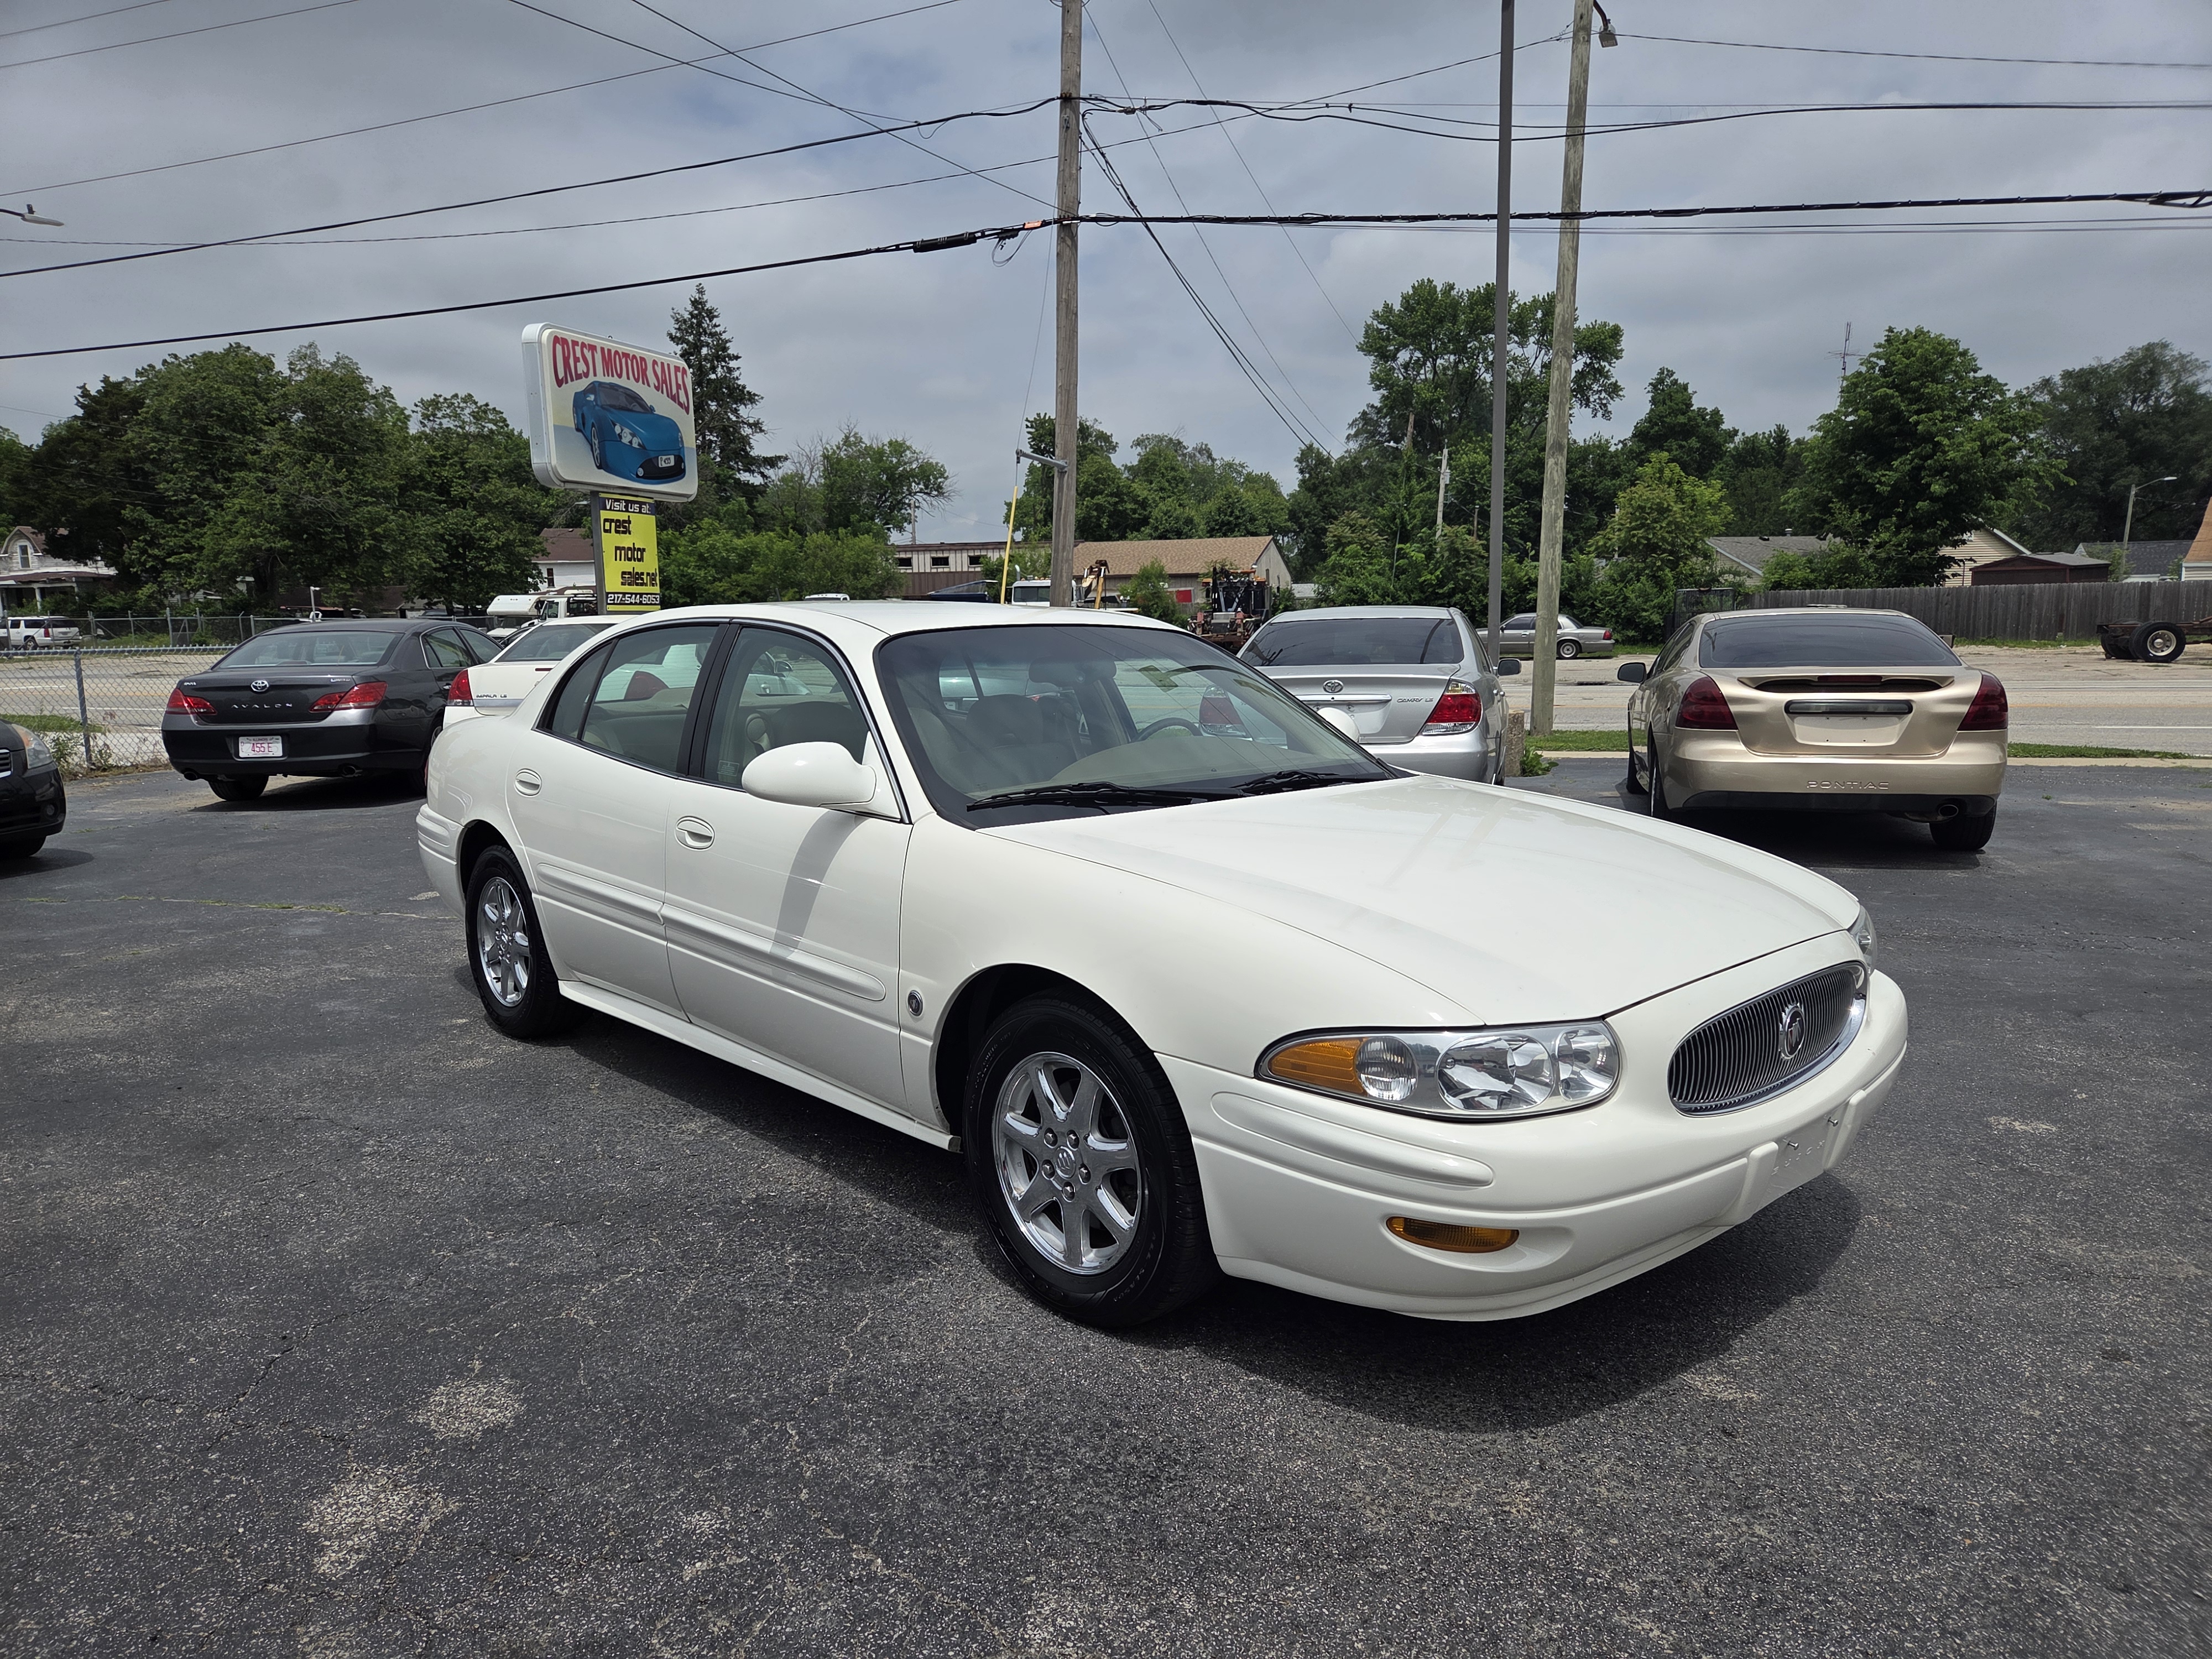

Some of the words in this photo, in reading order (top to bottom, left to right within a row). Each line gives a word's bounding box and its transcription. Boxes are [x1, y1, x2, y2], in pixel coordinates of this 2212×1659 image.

[552, 335, 598, 388] CREST
[600, 346, 651, 388] MOTOR
[651, 359, 690, 415] SALES
[606, 499, 625, 511] Visit
[628, 503, 639, 512] us
[641, 503, 651, 513] at:
[603, 515, 632, 535] crest
[614, 542, 646, 562] motor
[620, 567, 658, 587] sales.net
[607, 593, 660, 604] 217-544-6053
[251, 742, 265, 753] 455
[267, 742, 274, 753] E
[1806, 780, 1890, 789] PONTIAC
